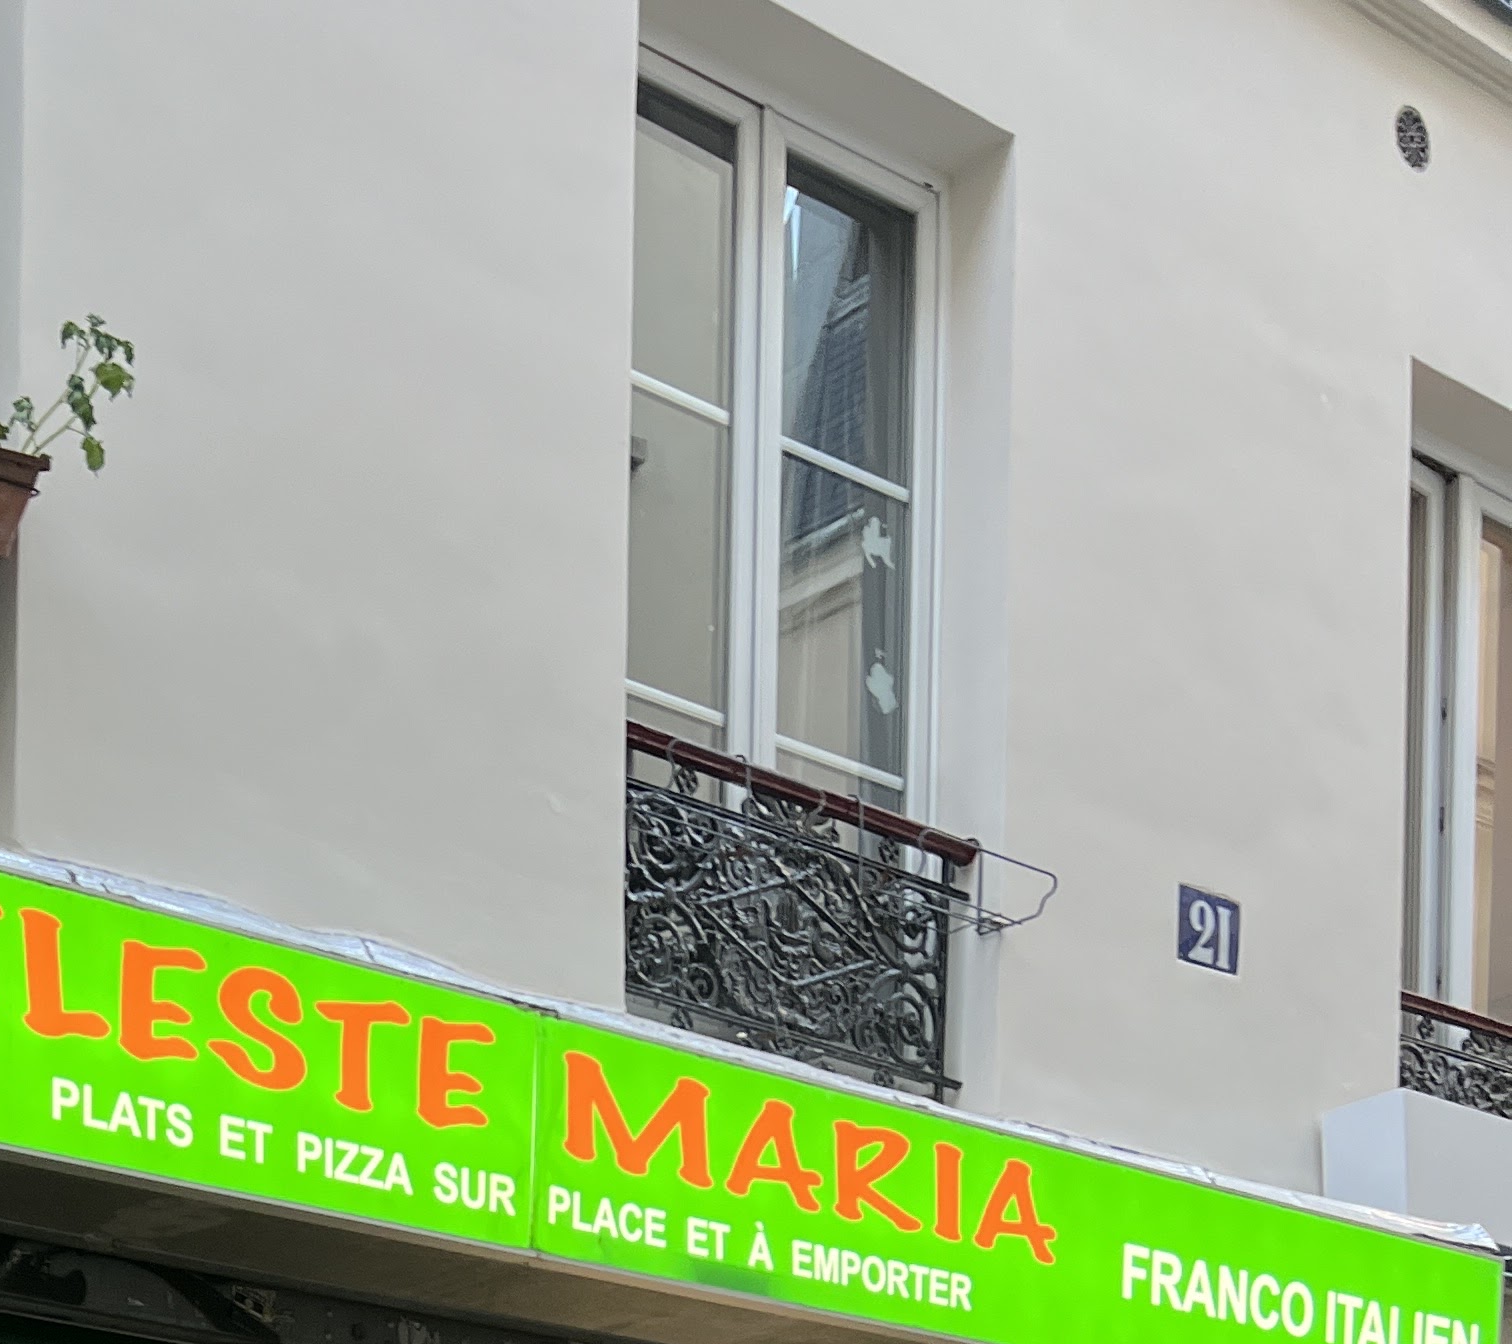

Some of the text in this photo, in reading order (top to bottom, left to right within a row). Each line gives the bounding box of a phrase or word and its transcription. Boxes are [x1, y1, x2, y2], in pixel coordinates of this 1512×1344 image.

[1187, 899, 1232, 970] 21
[51, 1076, 973, 1312] PLATS ET PIZZA SUR PLACE ET À EMPORTER
[563, 1051, 1057, 1264] MARIA
[1121, 1242, 1315, 1339] FRANCO
